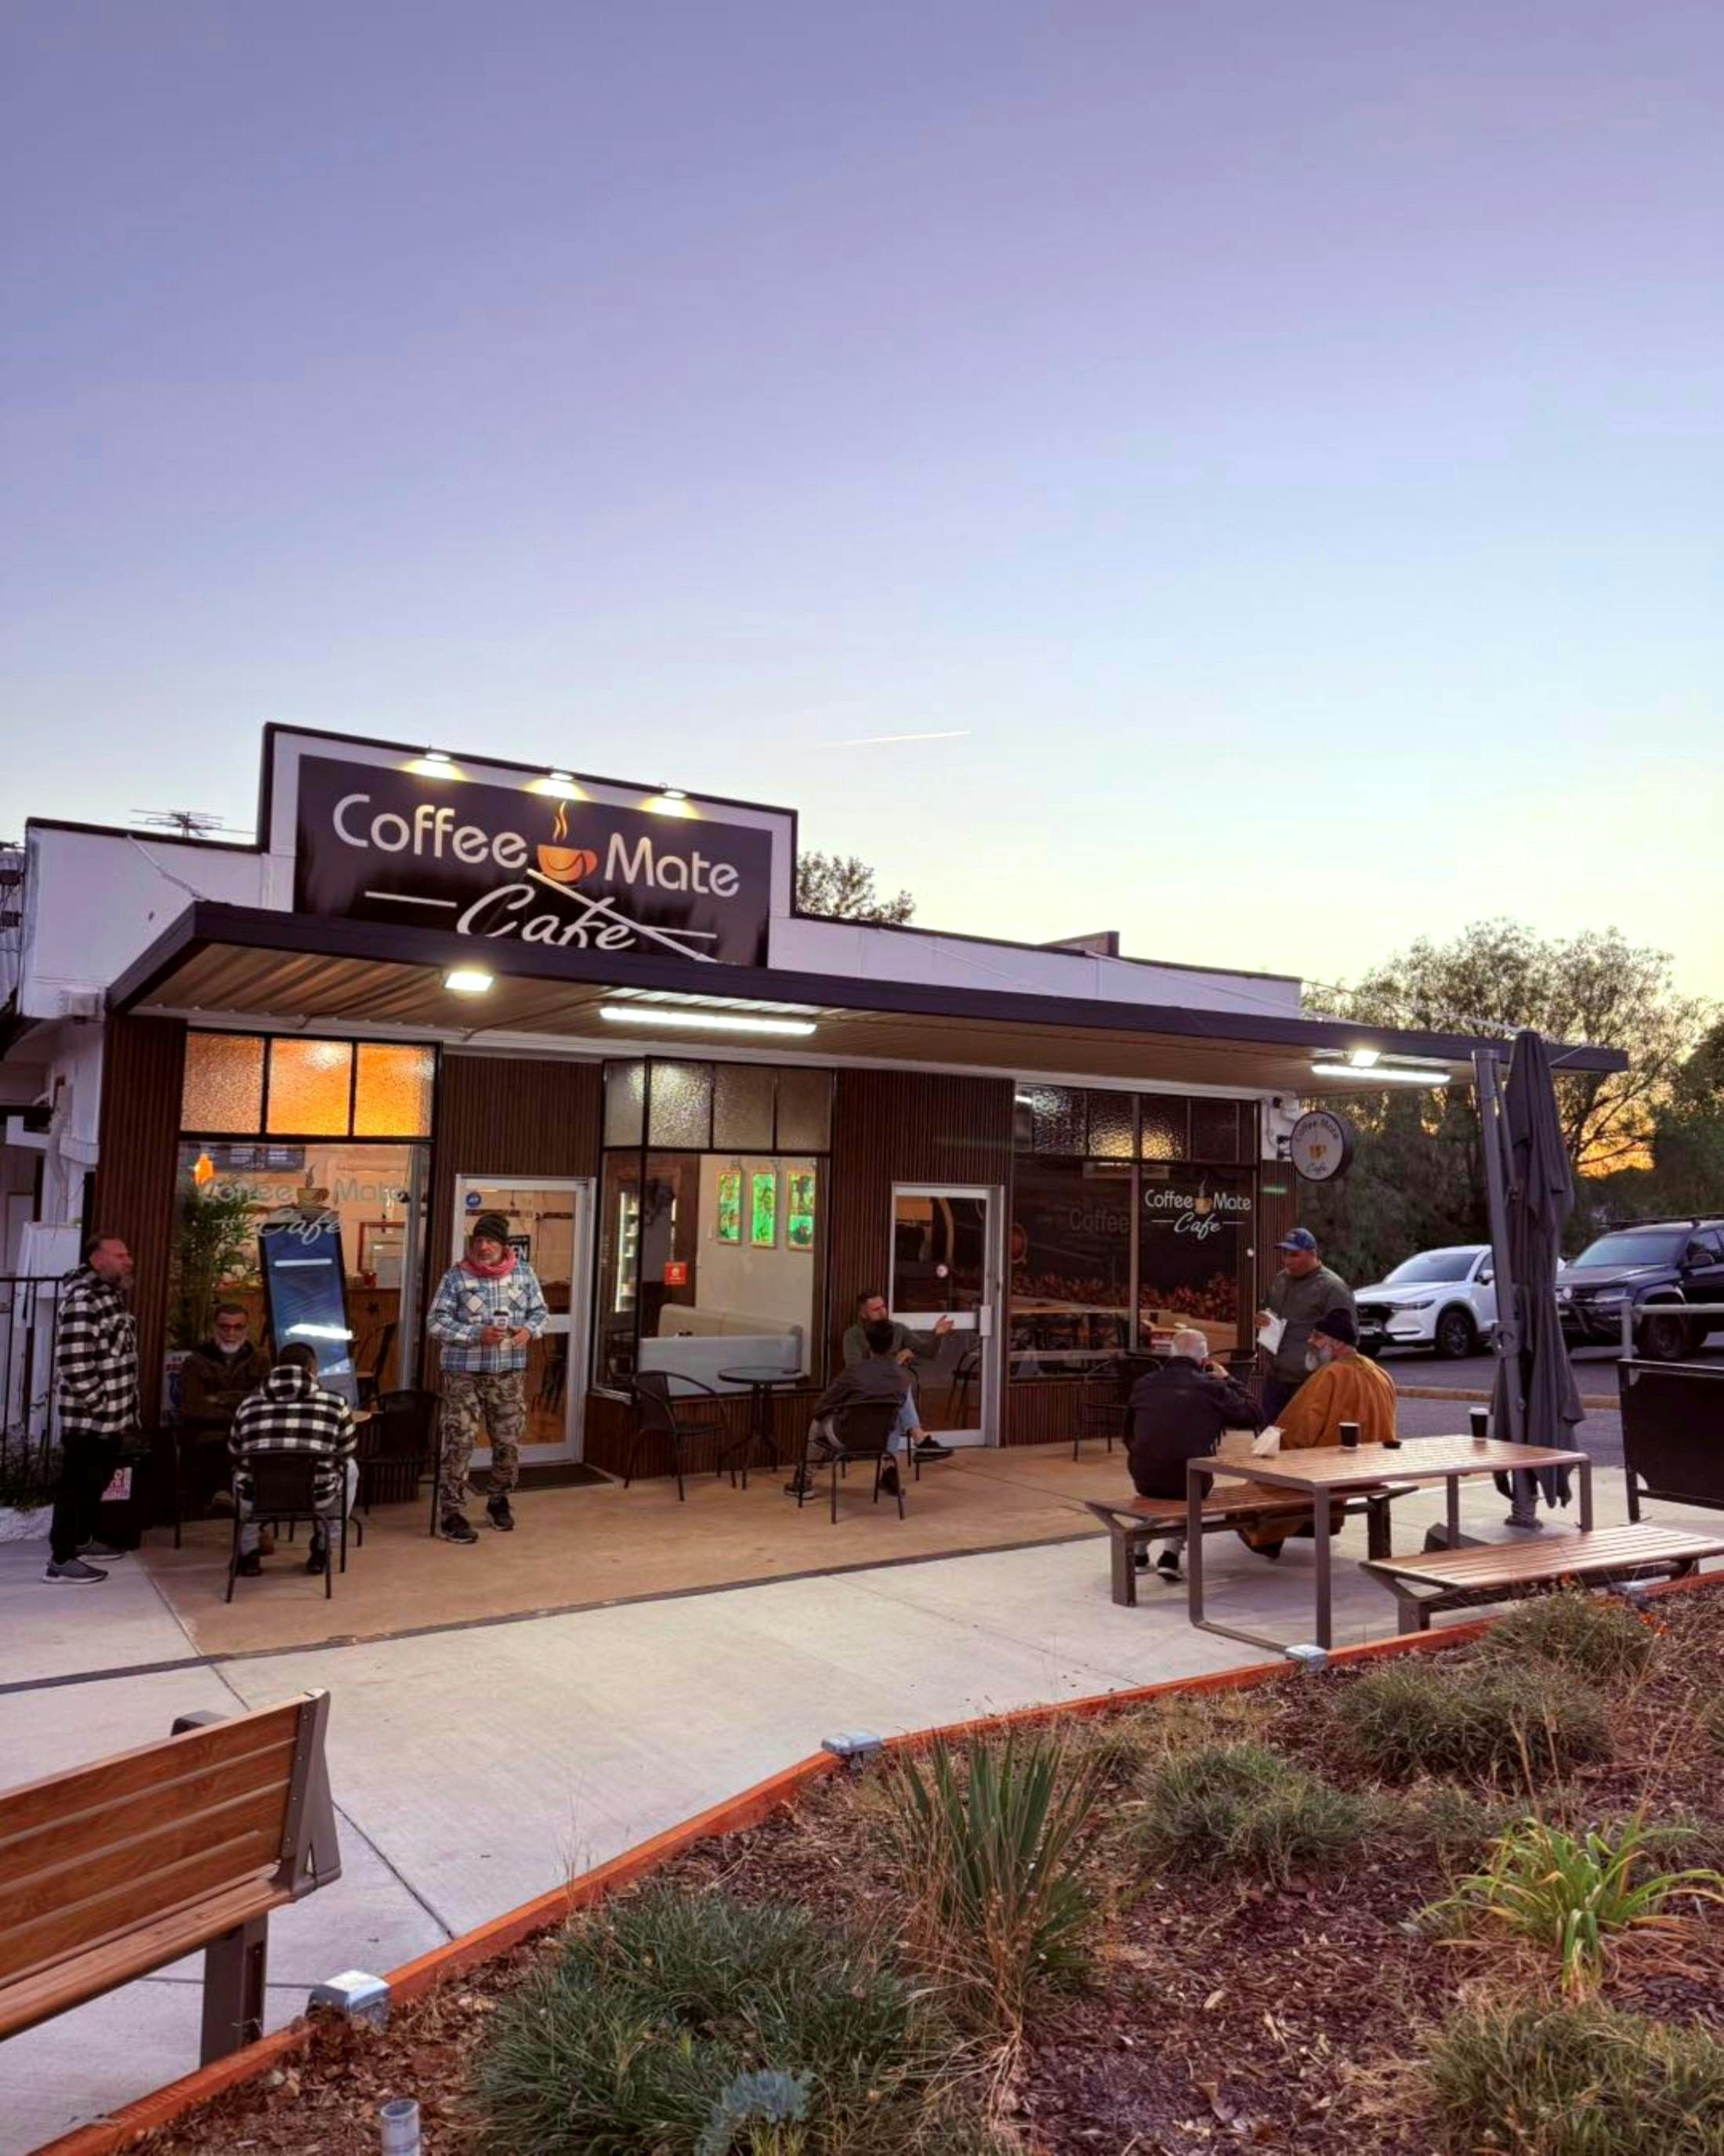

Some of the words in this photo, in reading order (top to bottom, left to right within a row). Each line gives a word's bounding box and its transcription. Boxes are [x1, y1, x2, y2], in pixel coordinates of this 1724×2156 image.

[333, 794, 528, 869] Coffee
[604, 832, 740, 898] Mate
[1145, 1189, 1193, 1209] Coffee
[1213, 1192, 1252, 1211] Mate
[256, 1207, 342, 1245] Cafe
[1174, 1212, 1222, 1240] Cafe
